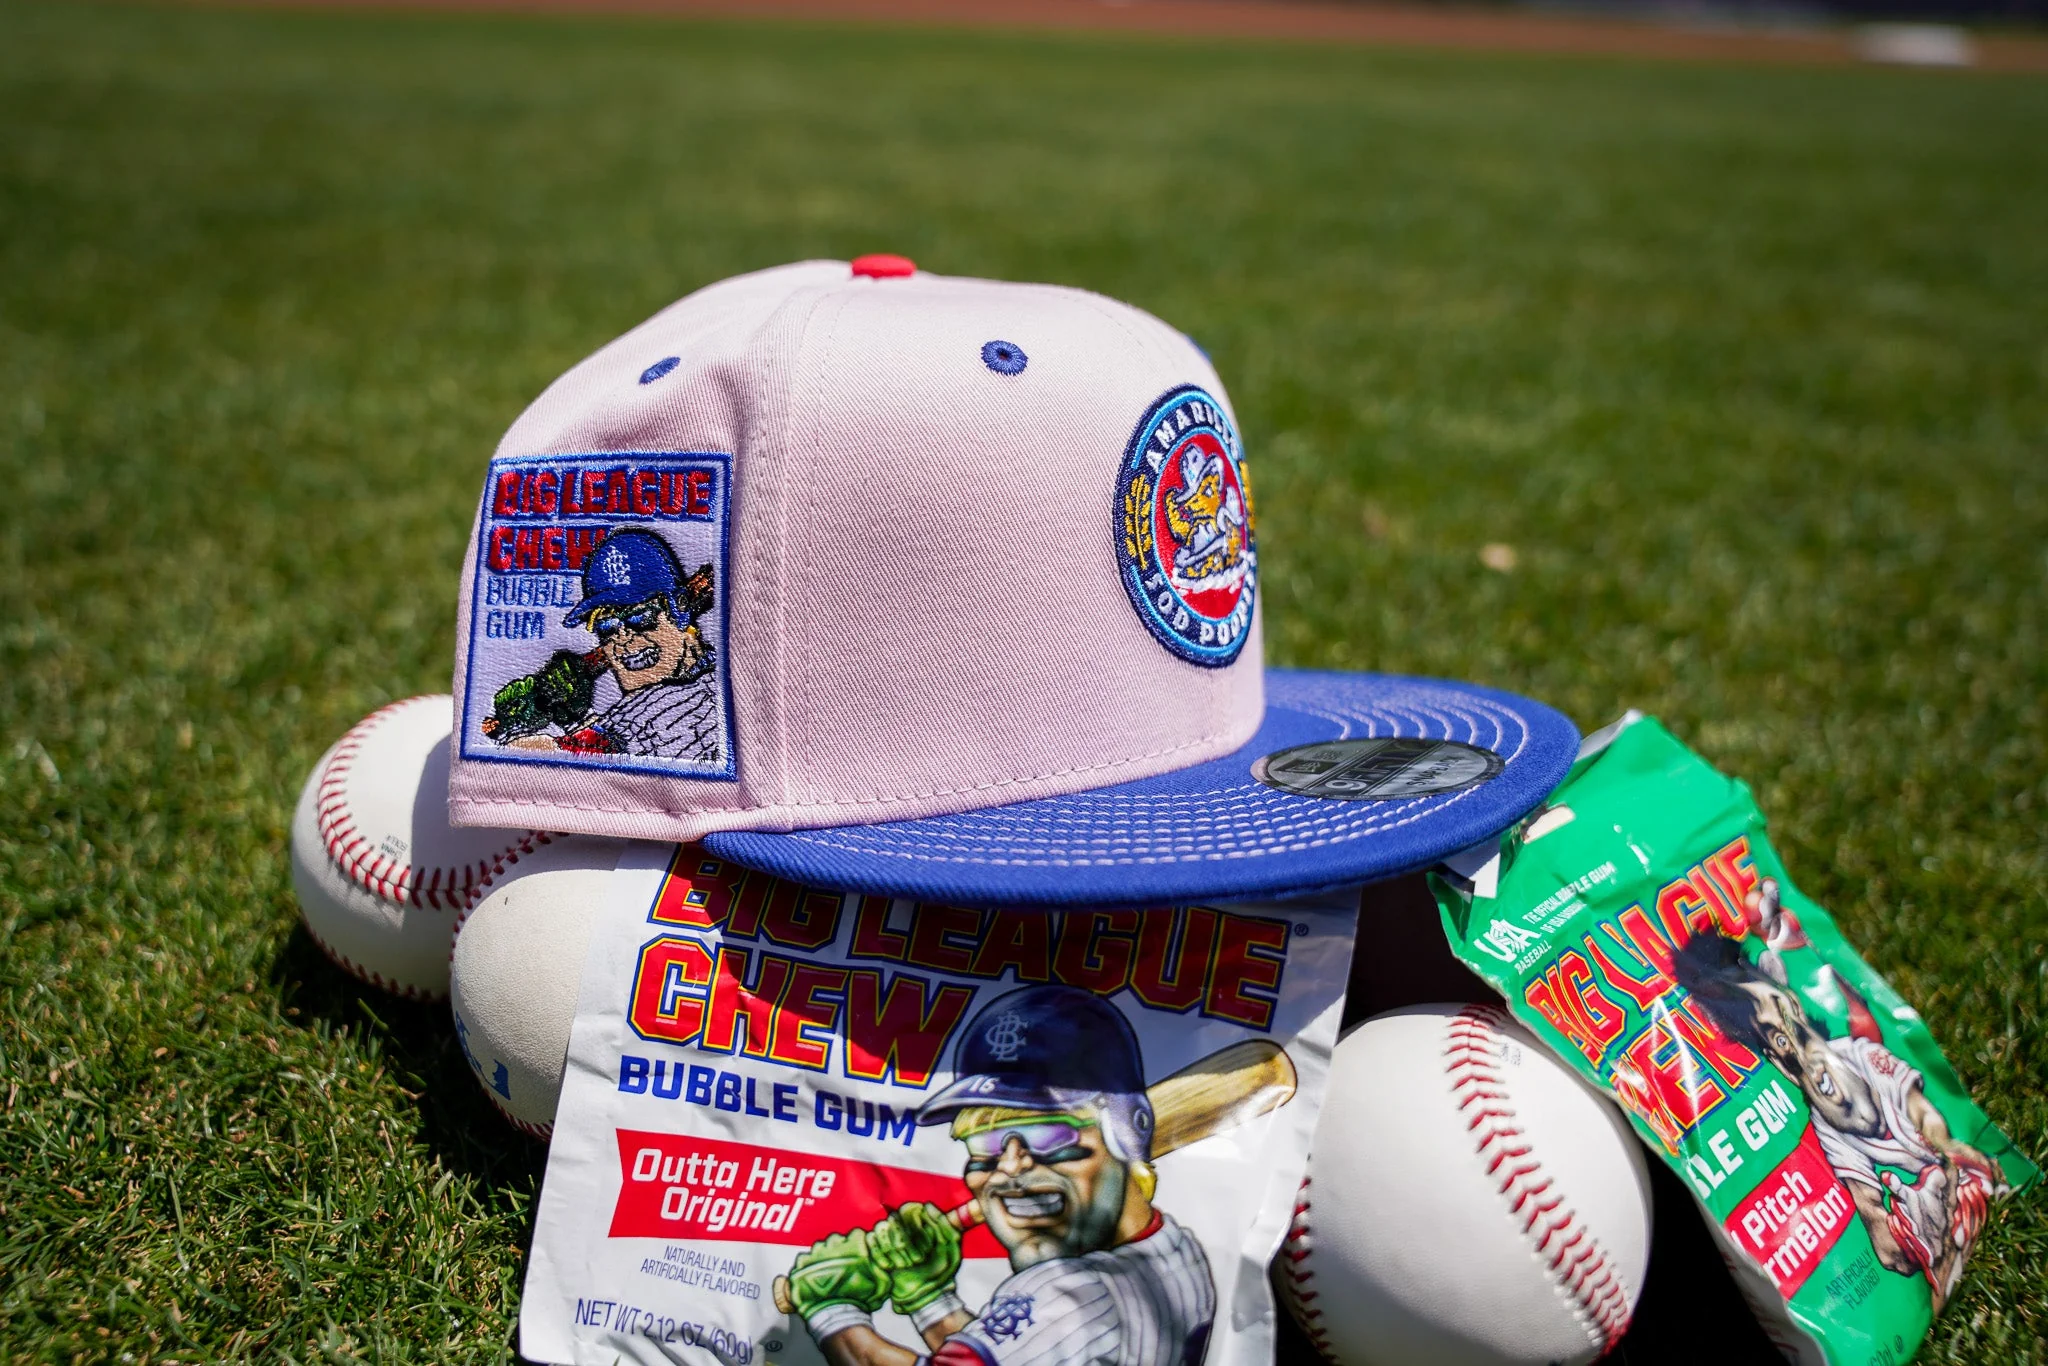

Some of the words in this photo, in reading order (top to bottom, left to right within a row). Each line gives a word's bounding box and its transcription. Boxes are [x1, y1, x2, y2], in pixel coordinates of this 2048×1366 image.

[492, 469, 558, 517] BIG
[559, 469, 712, 517] LEAGUE
[488, 525, 606, 571] CHEW
[486, 575, 575, 607] BUBBLE
[1144, 572, 1191, 632] SOD
[486, 609, 545, 639] GUM
[646, 844, 846, 954] BIG
[1473, 919, 1542, 963] USA
[1514, 940, 1552, 975] BASEBALL
[626, 933, 980, 1090] CHEW
[1525, 946, 1627, 1069] BIG
[617, 1055, 799, 1124] BUBBLE
[814, 1091, 916, 1147] GUM
[1735, 1080, 1797, 1152] GUM
[632, 1148, 741, 1190] Outta
[746, 1156, 837, 1199] Here
[1741, 1170, 1814, 1250] Pitch
[640, 1258, 702, 1286] ARTIFICIALLY
[701, 1274, 761, 1300] FLAVORED
[663, 1245, 720, 1272] NATURALLY
[719, 1260, 746, 1278] AND
[1825, 1247, 1873, 1299] ARTIFICIALLY
[1842, 1267, 1880, 1310] FLAVORED
[575, 1298, 617, 1328] NET
[614, 1303, 642, 1335] WT
[681, 1320, 706, 1348] OZ
[709, 1326, 754, 1365] (60g)
